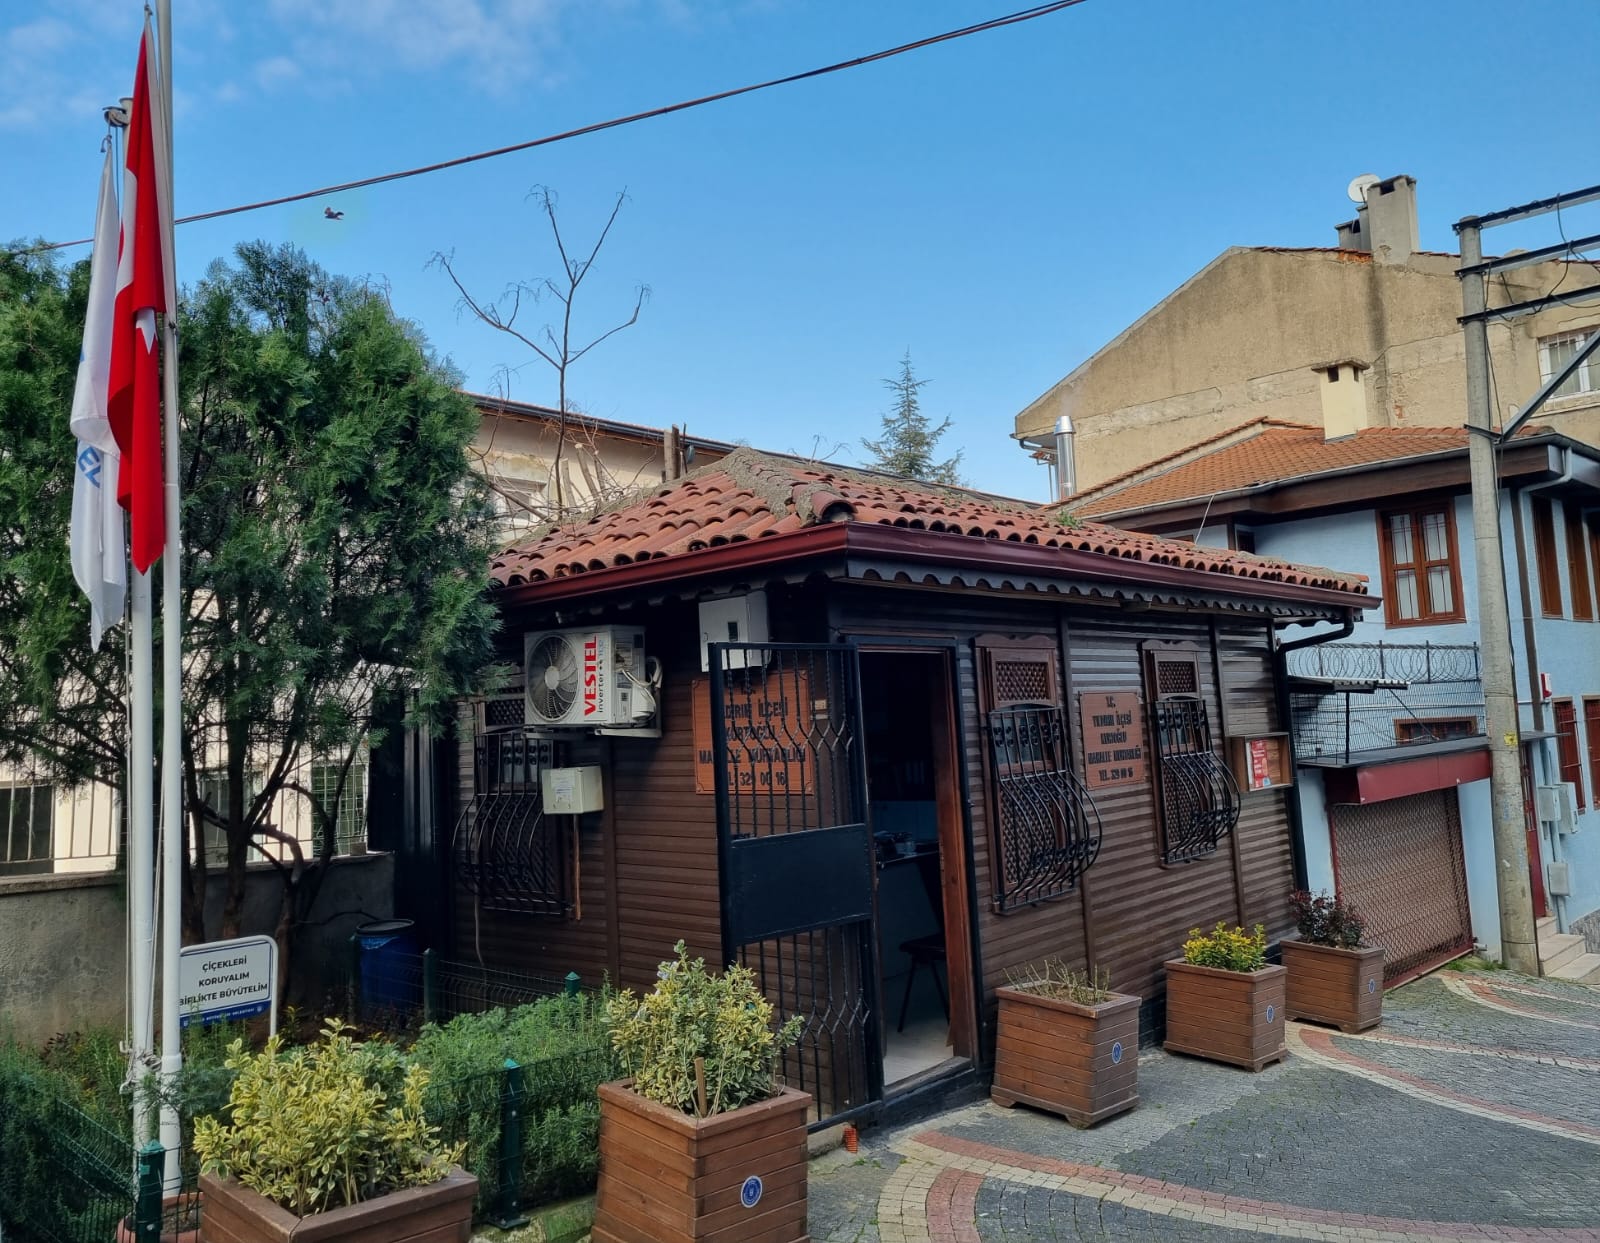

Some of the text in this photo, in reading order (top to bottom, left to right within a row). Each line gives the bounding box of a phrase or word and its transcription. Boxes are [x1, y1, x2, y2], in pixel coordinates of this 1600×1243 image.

[584, 634, 597, 716] VESTEL
[202, 955, 247, 973] ÇİÇEKLERİ
[198, 972, 250, 987] KORUYALIM
[219, 982, 268, 999] BÜYÜTELİM
